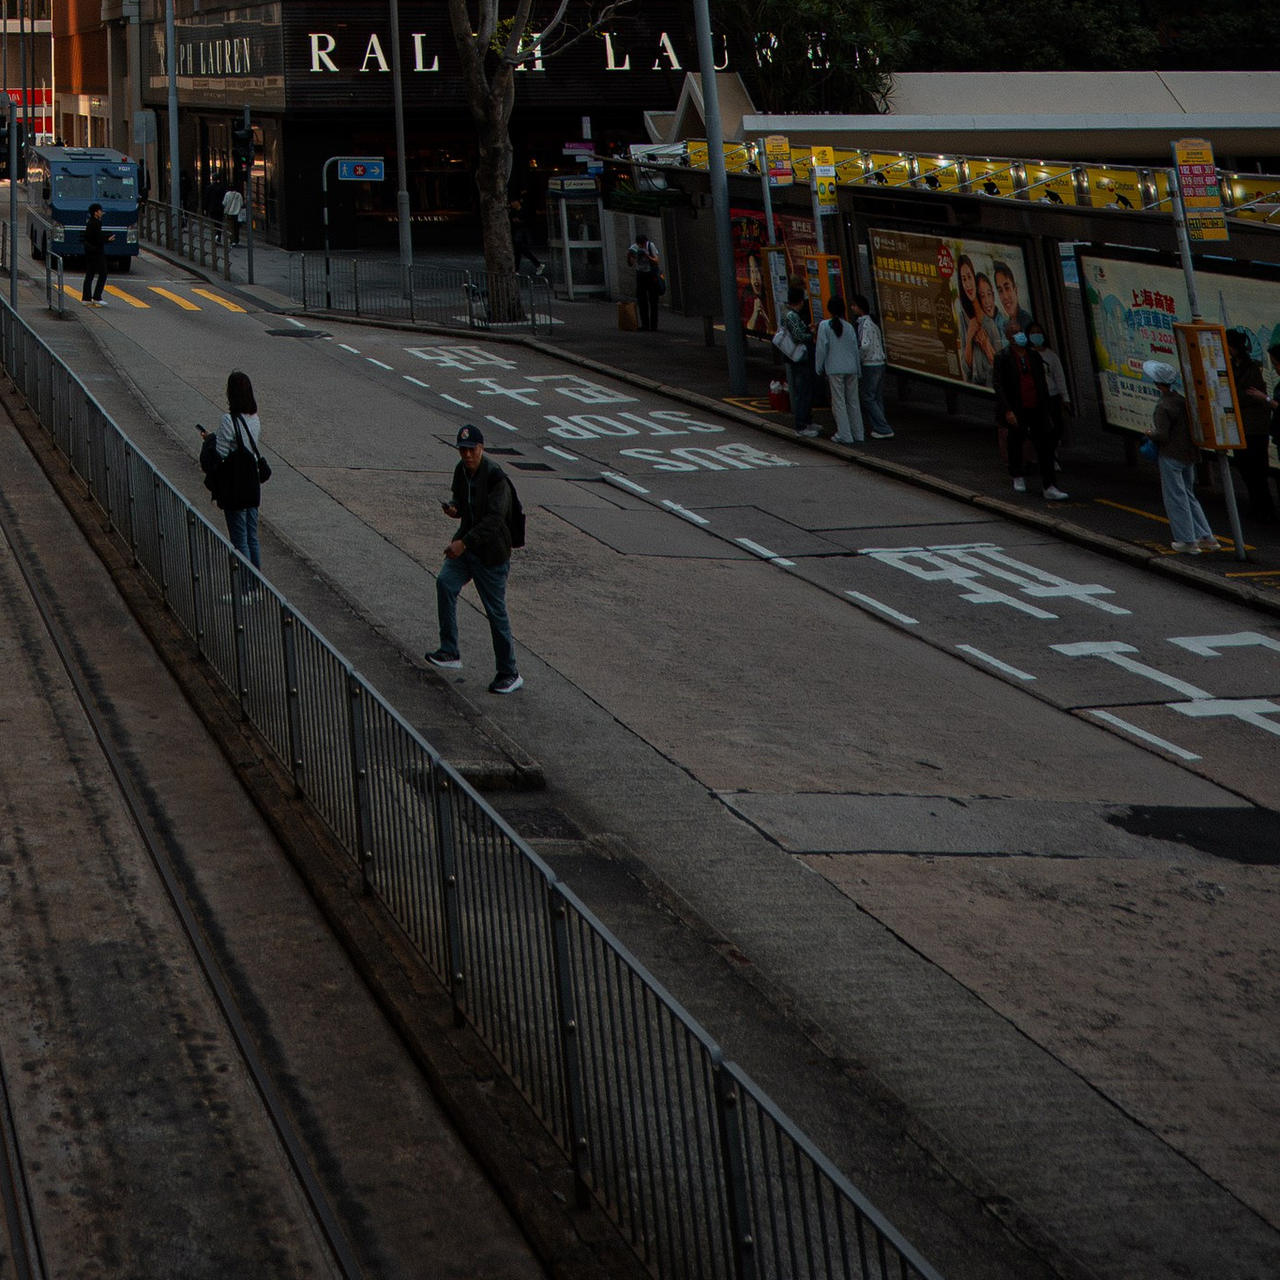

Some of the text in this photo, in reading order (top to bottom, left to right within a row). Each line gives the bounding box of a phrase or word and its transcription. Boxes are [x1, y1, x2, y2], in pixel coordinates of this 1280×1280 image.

[160, 38, 250, 75] RPH LAUREN
[308, 33, 546, 72] RALH
[1114, 181, 1134, 191] Citybus
[937, 255, 953, 268] 24%
[1132, 289, 1175, 315] 上海商業
[543, 410, 726, 440] STOP
[619, 442, 799, 473] BUS
[1048, 631, 1280, 736] 士
